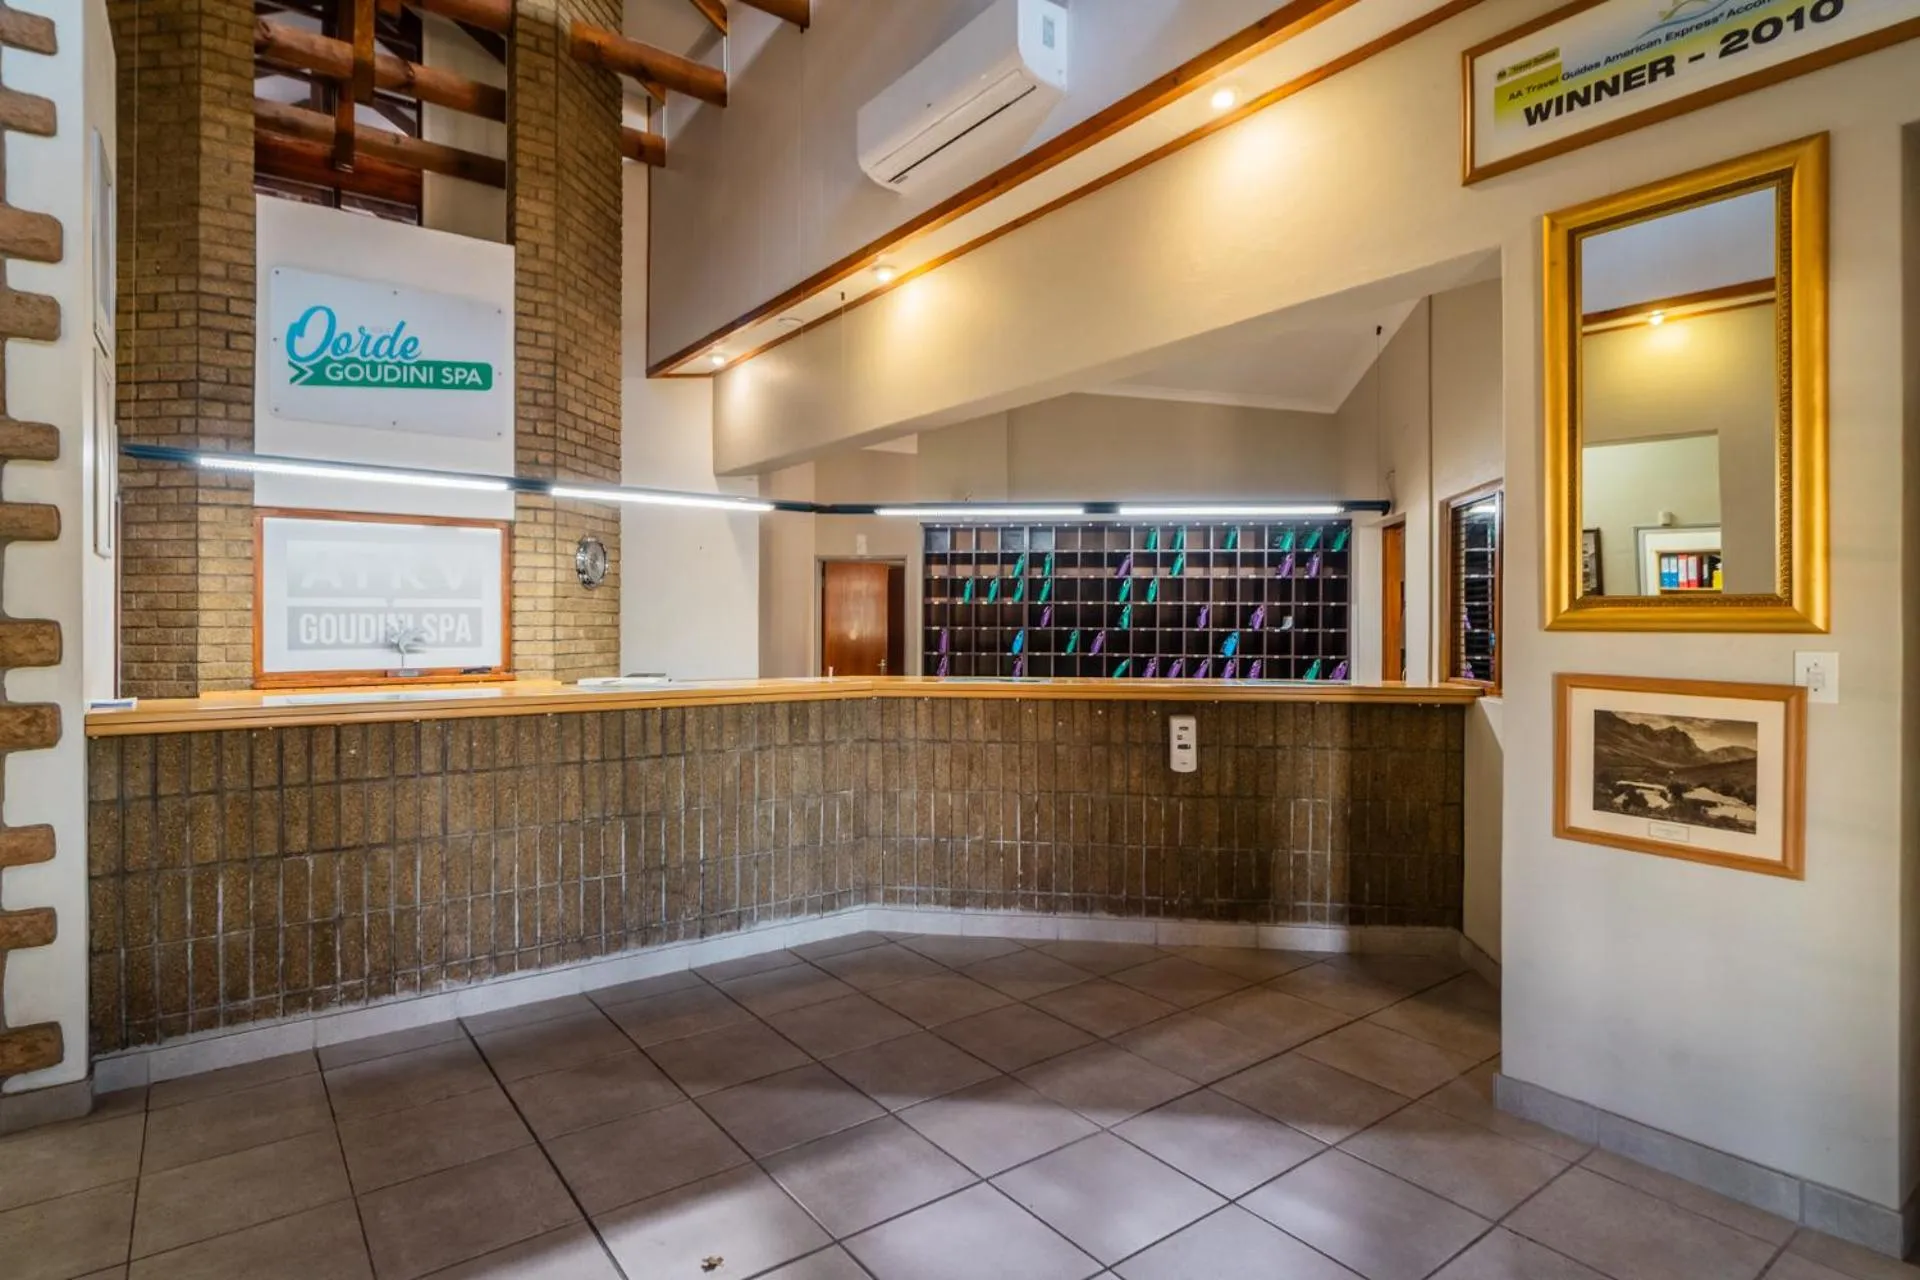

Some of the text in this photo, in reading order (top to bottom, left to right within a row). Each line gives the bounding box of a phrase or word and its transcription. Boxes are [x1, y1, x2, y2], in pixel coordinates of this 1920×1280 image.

[1523, 54, 1675, 127] WINNER
[1718, 0, 1844, 59] 2010
[1526, 76, 1560, 93] Travel
[1561, 60, 1601, 82] Guides
[1604, 38, 1662, 66] American
[285, 305, 422, 363] Oorde
[324, 362, 483, 386] GOUDINI SPA
[421, 613, 472, 643] SPA
